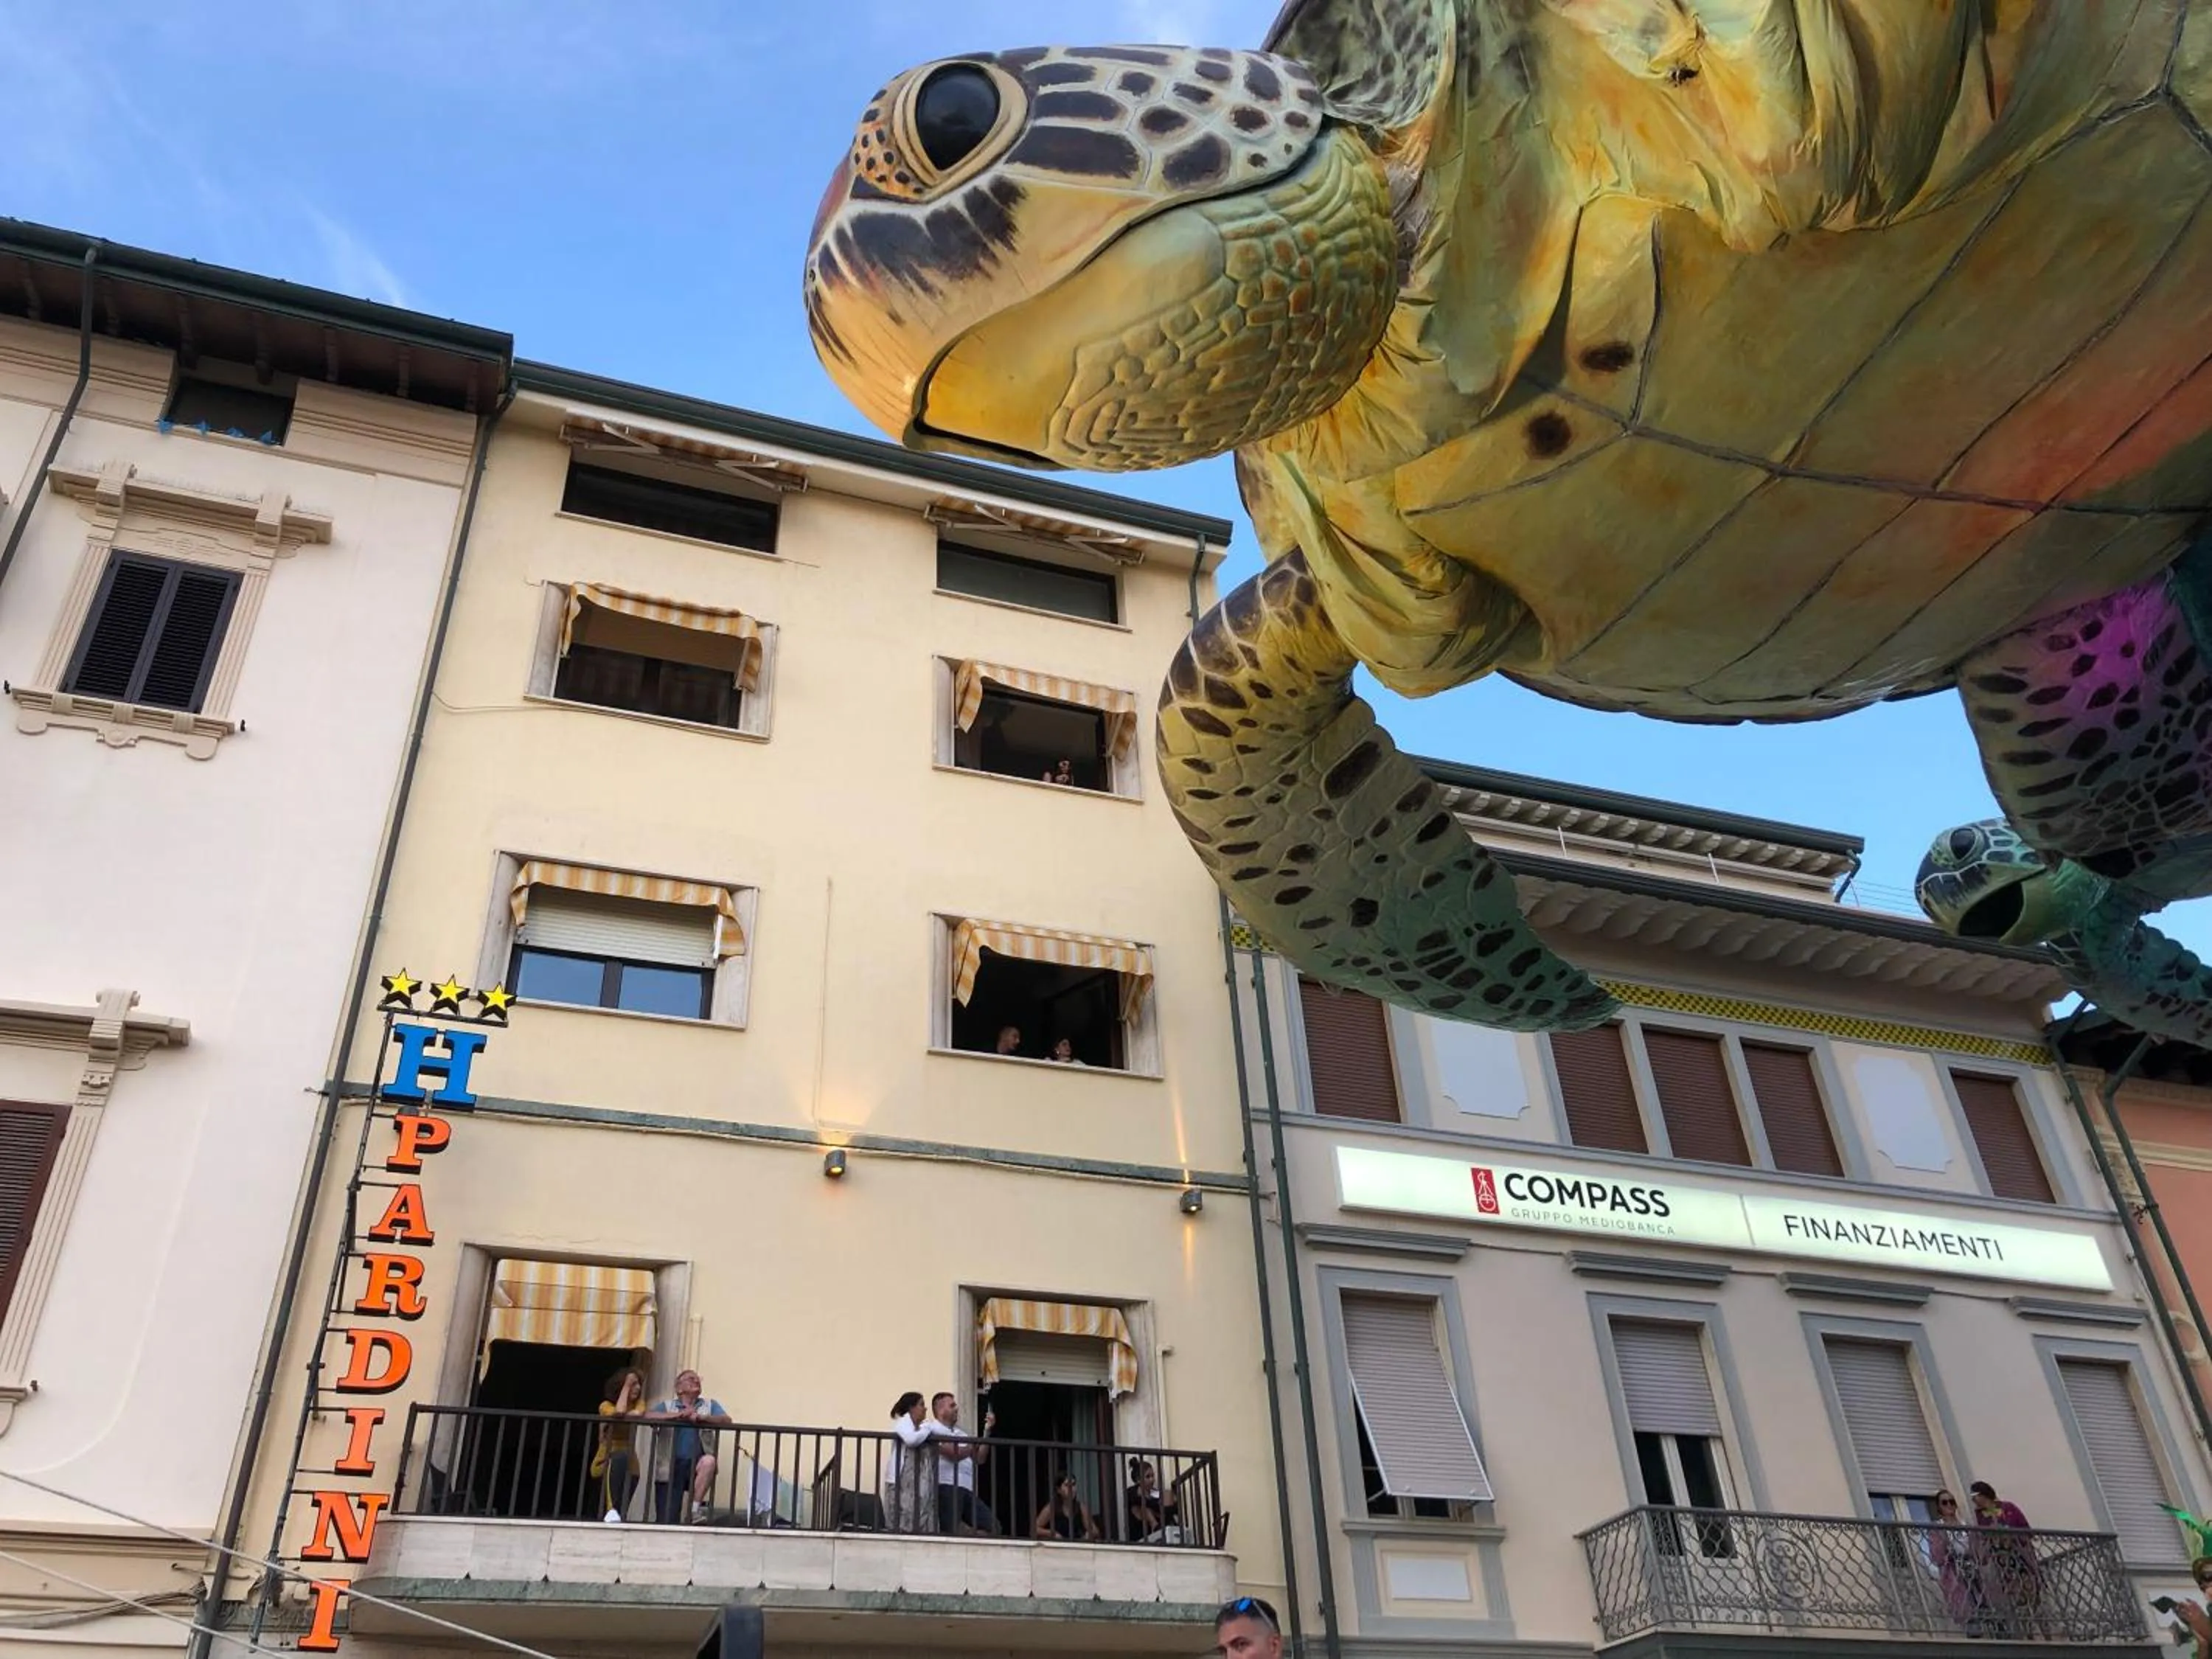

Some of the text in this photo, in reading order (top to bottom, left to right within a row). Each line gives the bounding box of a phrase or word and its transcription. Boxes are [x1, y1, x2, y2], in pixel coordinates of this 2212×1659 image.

[381, 1023, 487, 1112] H
[1504, 1172, 1670, 1217] COMPASS
[1512, 1207, 1676, 1236] GRUPPO MEDIOBANCA
[1784, 1214, 2003, 1261] FINANZIAMENTI
[297, 1114, 451, 1652] PARDINI
